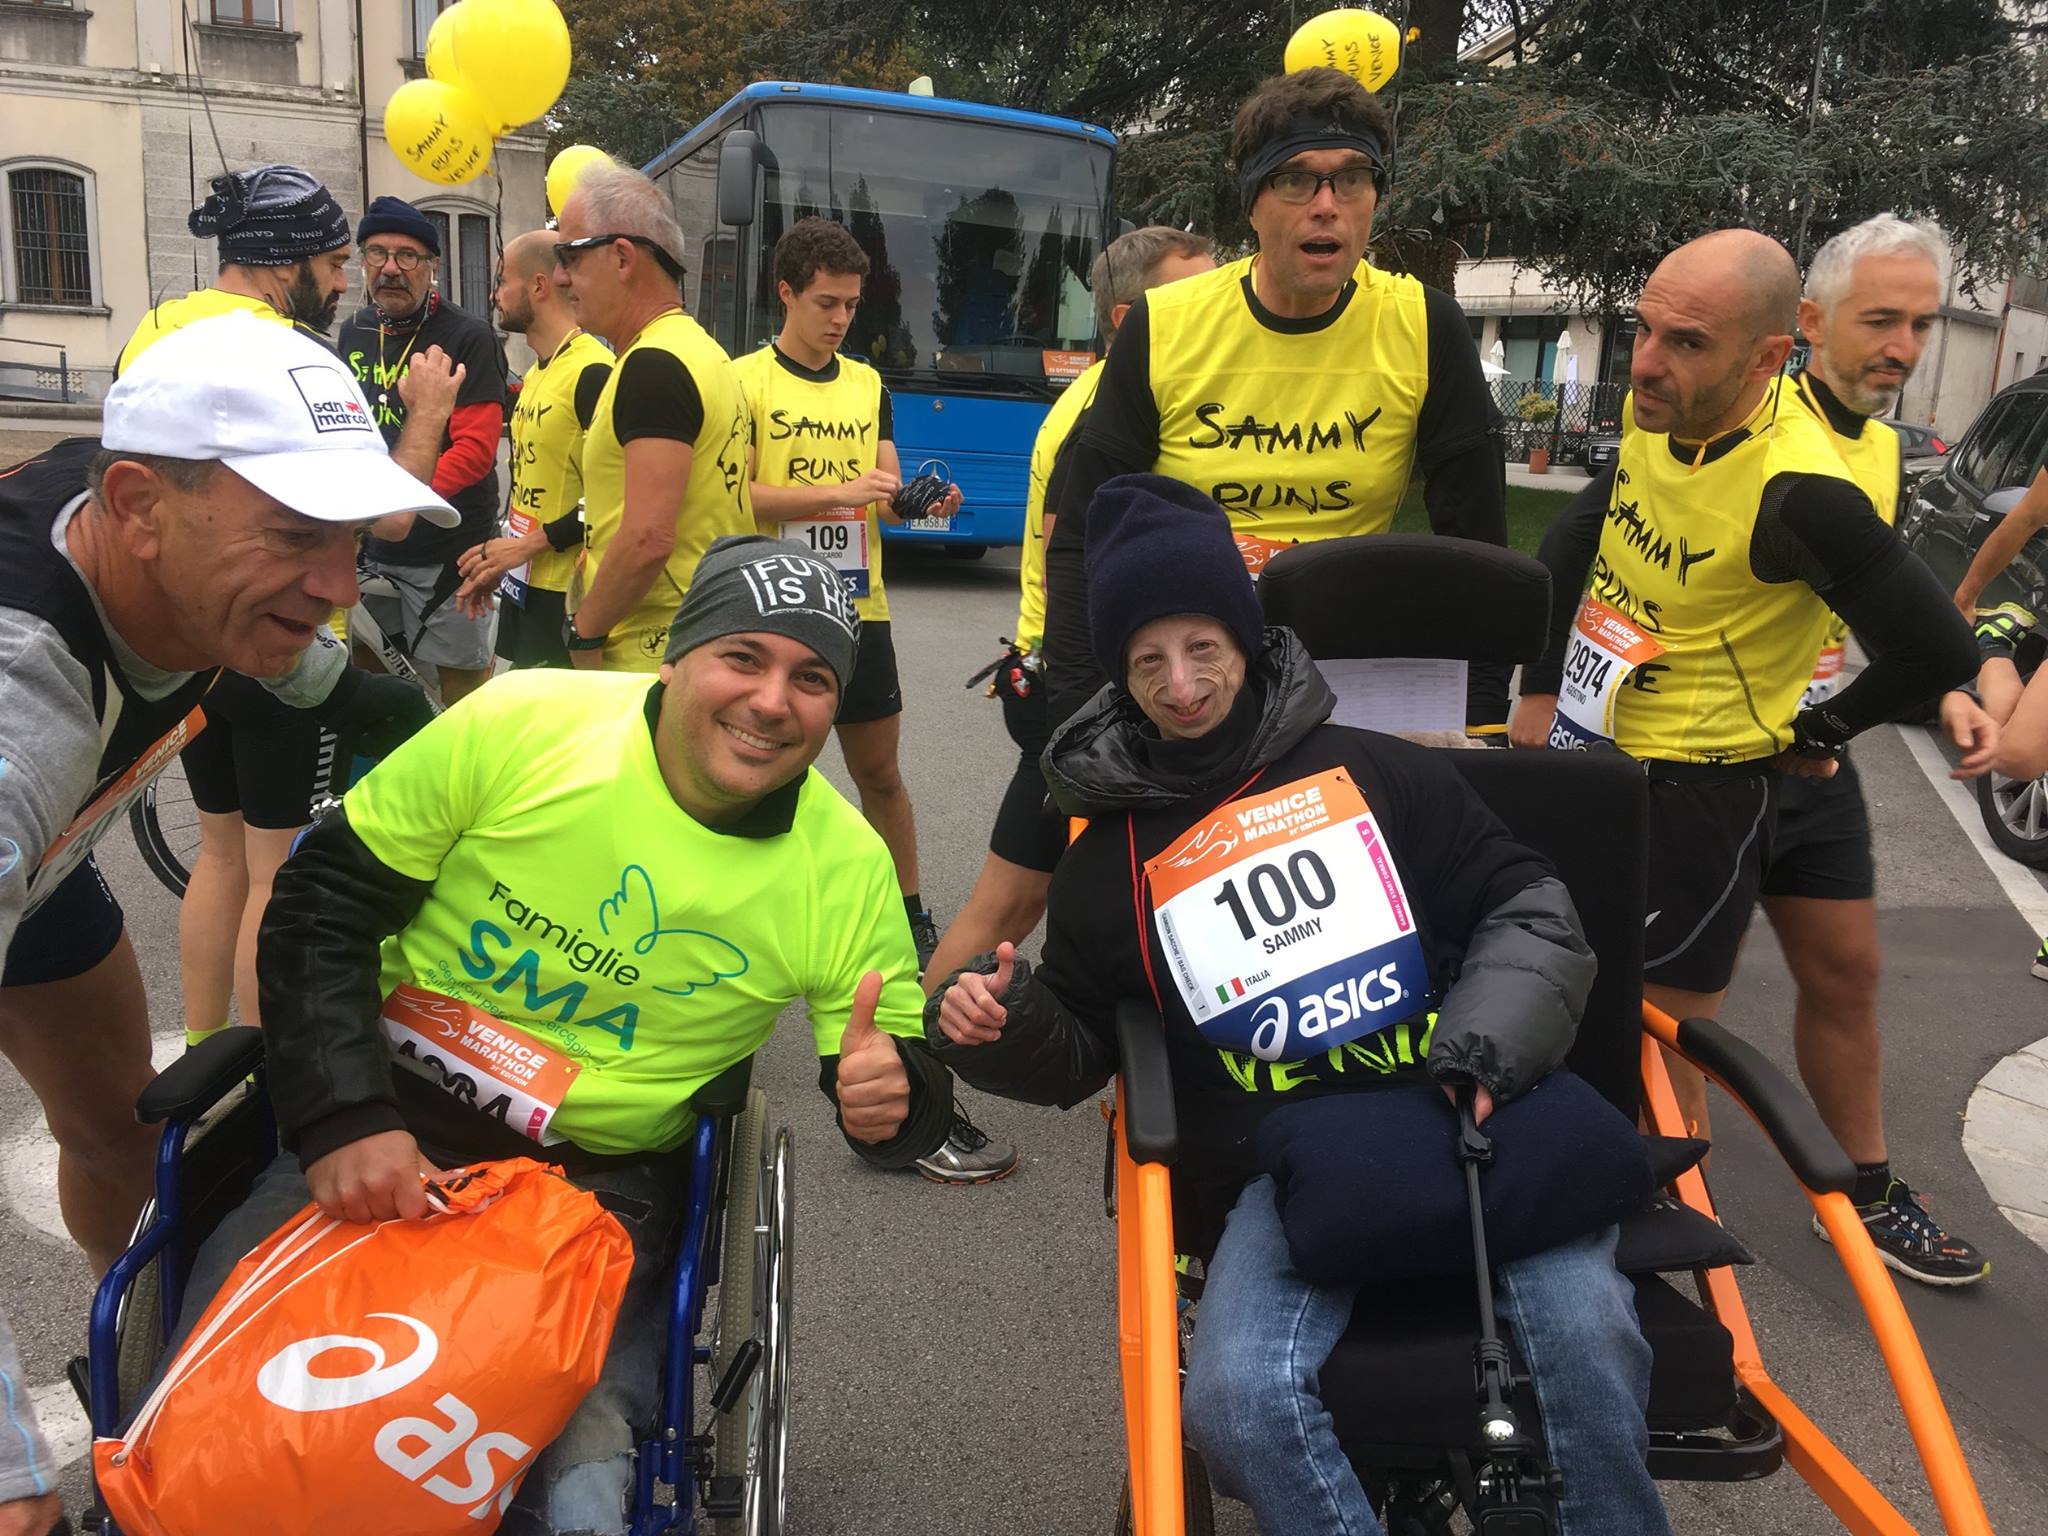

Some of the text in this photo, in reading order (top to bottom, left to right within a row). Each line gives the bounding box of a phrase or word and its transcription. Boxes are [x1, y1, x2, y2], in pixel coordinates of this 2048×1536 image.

[1345, 41, 1360, 75] UNS
[1367, 32, 1383, 84] VENICE
[406, 113, 449, 162] SAMMY
[313, 401, 343, 413] san
[316, 414, 367, 426] marco
[512, 402, 552, 429] AMMY
[769, 410, 872, 445] SAMMY
[1188, 403, 1383, 454] SAMMY
[788, 457, 861, 486] RUNS
[1211, 480, 1356, 521] RUNS
[806, 525, 848, 551] 109
[1608, 468, 1716, 588] SAMMY
[764, 577, 807, 607] IS
[1592, 552, 1664, 634] RUNS
[1597, 626, 1633, 650] MARATHON
[1601, 616, 1644, 646] VENICE
[1564, 638, 1613, 699] 2974
[1236, 786, 1323, 828] VENICE
[1243, 802, 1327, 842] MARATHON
[1213, 848, 1336, 941] 100
[488, 880, 641, 988] Famiglie
[1262, 917, 1323, 956] SAMMY
[457, 919, 641, 1052] SMA
[1177, 959, 1188, 974] BAG
[1182, 971, 1196, 992] CHECK
[1244, 969, 1271, 988] ITALIA
[1298, 961, 1402, 1039] asics
[459, 1034, 537, 1080] MARATHON
[467, 1019, 549, 1070] VENICE
[499, 1068, 529, 1087] EDITION
